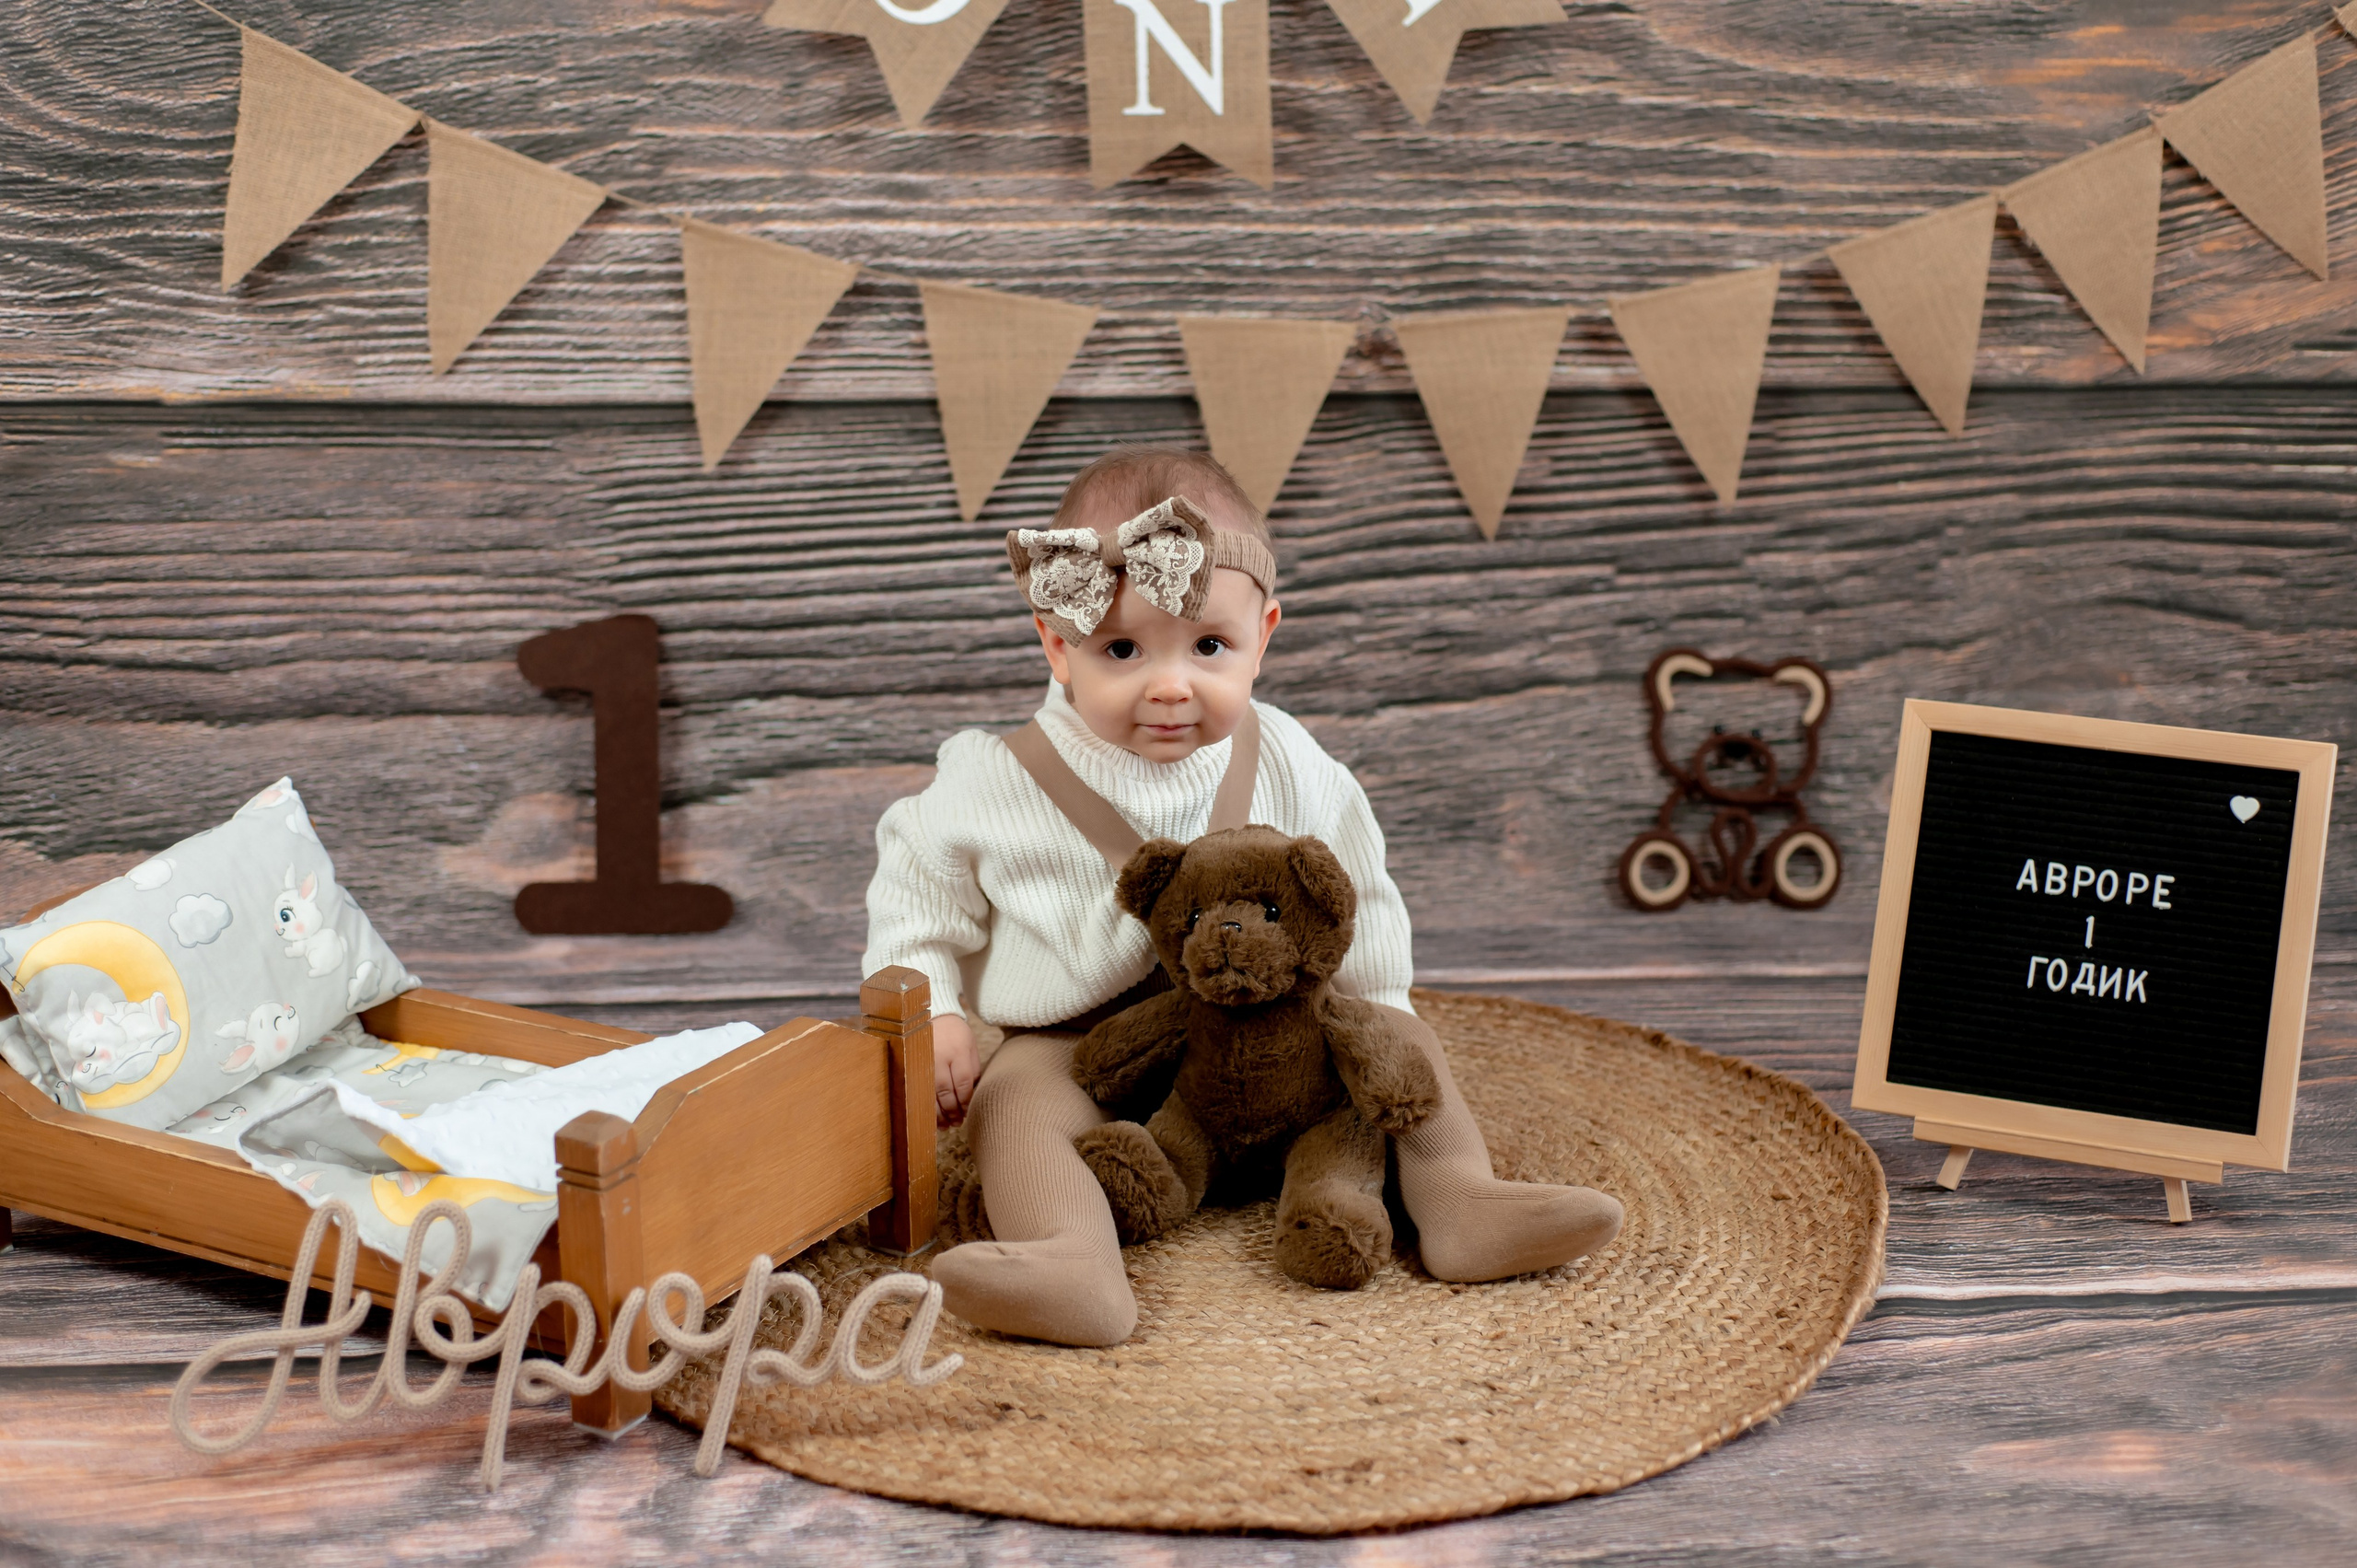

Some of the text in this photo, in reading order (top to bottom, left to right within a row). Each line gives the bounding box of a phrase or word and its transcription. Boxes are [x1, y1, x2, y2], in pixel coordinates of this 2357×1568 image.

[515, 614, 734, 935] 1
[2015, 858, 2177, 910] АВРОРЕ
[2084, 914, 2096, 949] 1
[2026, 955, 2149, 1004] ГОДИК
[170, 1199, 964, 1493] Аврора
